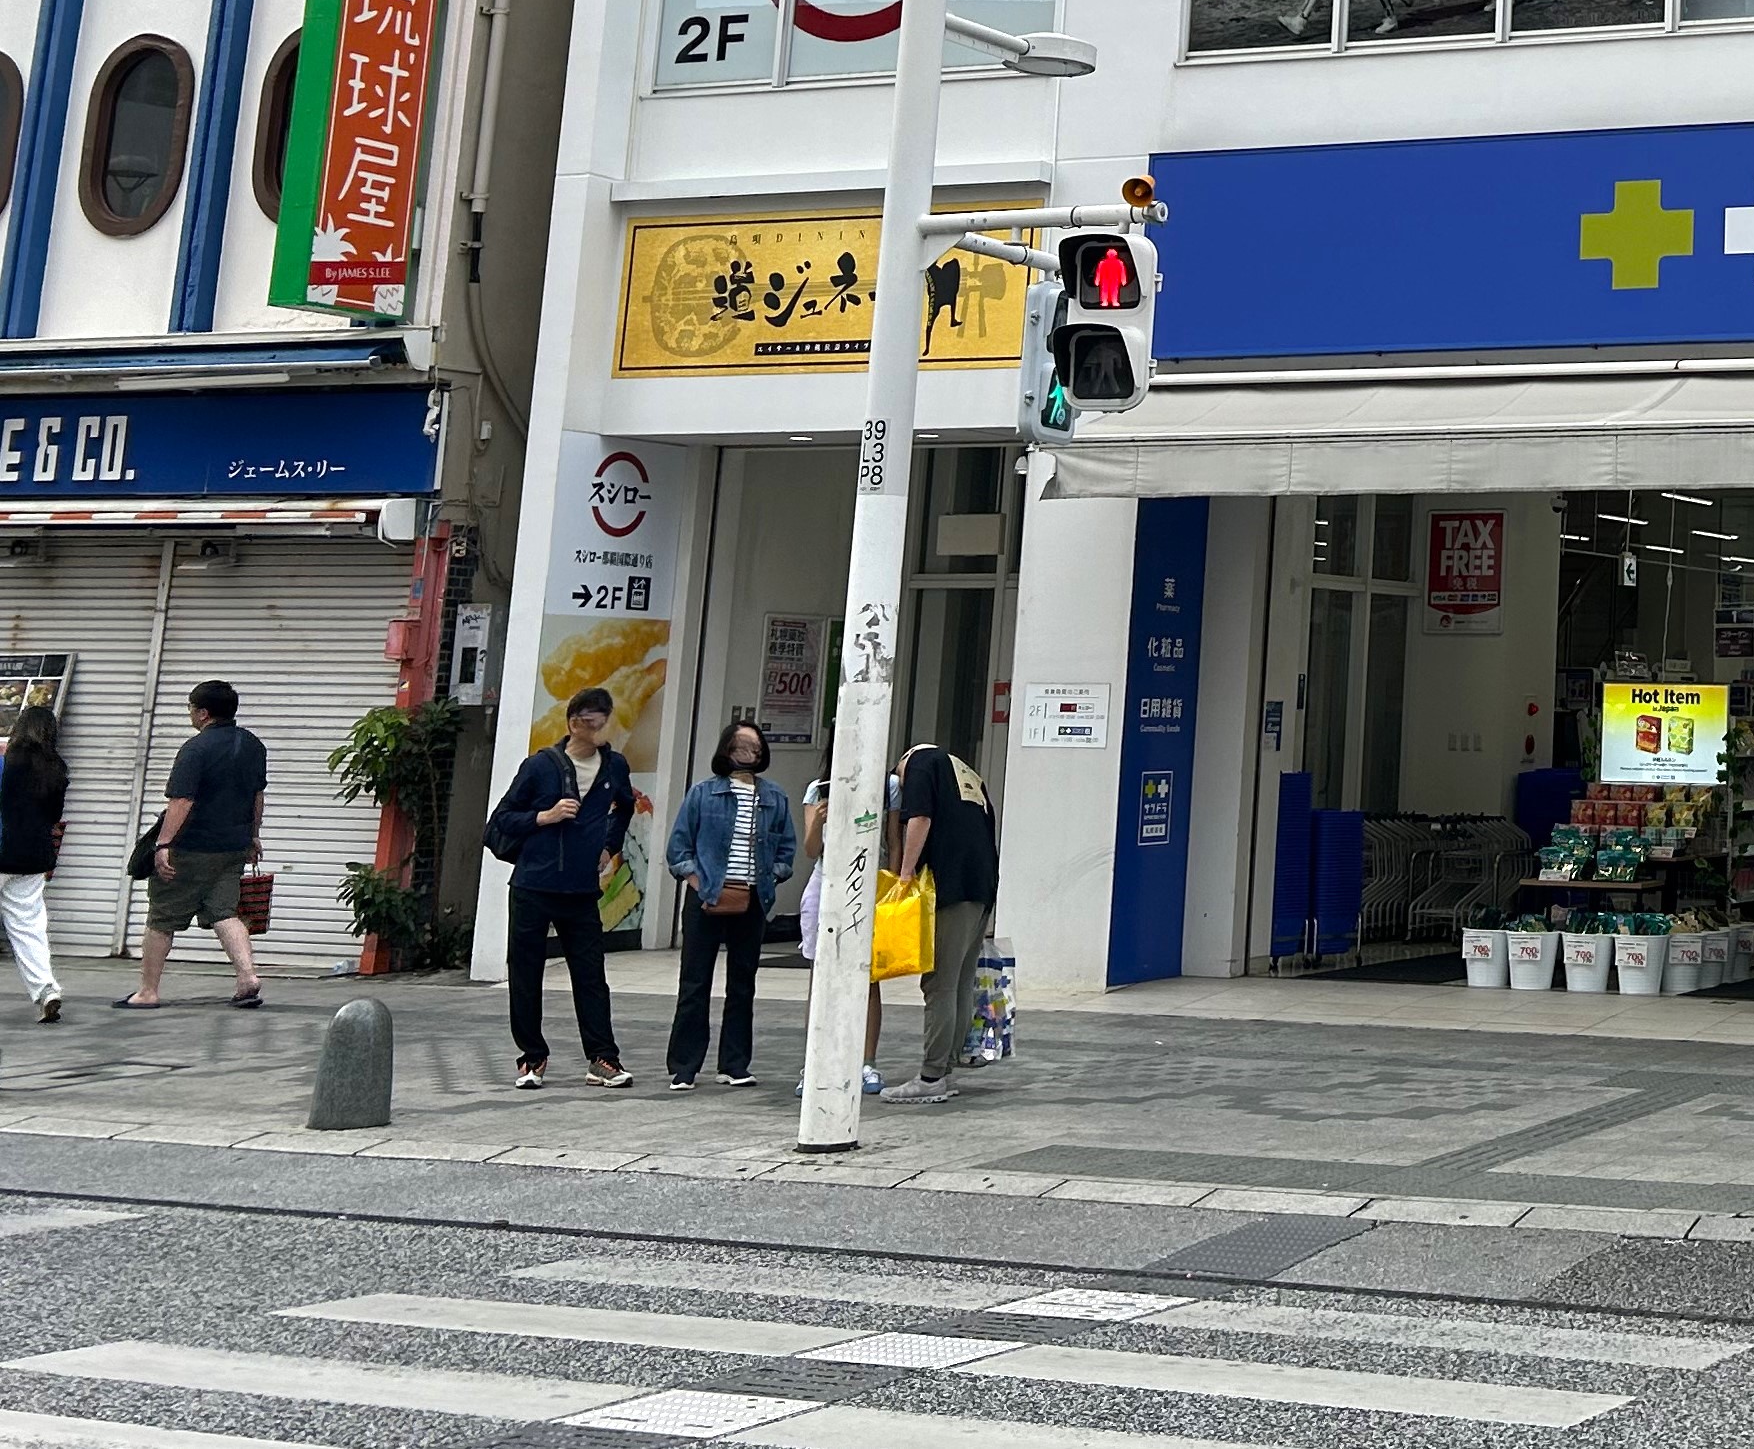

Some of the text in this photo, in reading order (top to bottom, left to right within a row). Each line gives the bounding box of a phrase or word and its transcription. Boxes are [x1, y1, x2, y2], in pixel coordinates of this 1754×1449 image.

[676, 14, 749, 63] 2F
[326, 268, 337, 281] By
[338, 267, 367, 279] JAMES
[710, 252, 876, 328] 道ジュネ
[864, 420, 886, 440] 39
[33, 417, 61, 483] &
[72, 415, 135, 482] CO.
[862, 443, 884, 463] L3
[228, 459, 346, 479] ジェームス・リー
[860, 465, 883, 485] P8
[588, 481, 651, 504] スシロー
[1439, 519, 1496, 549] TAX
[1440, 549, 1496, 577] FREE
[595, 585, 623, 609] 2F
[1731, 611, 1738, 623] 1
[1147, 637, 1184, 658] 化粧品
[1631, 689, 1701, 705] Hot Item
[1029, 705, 1042, 717] 2F
